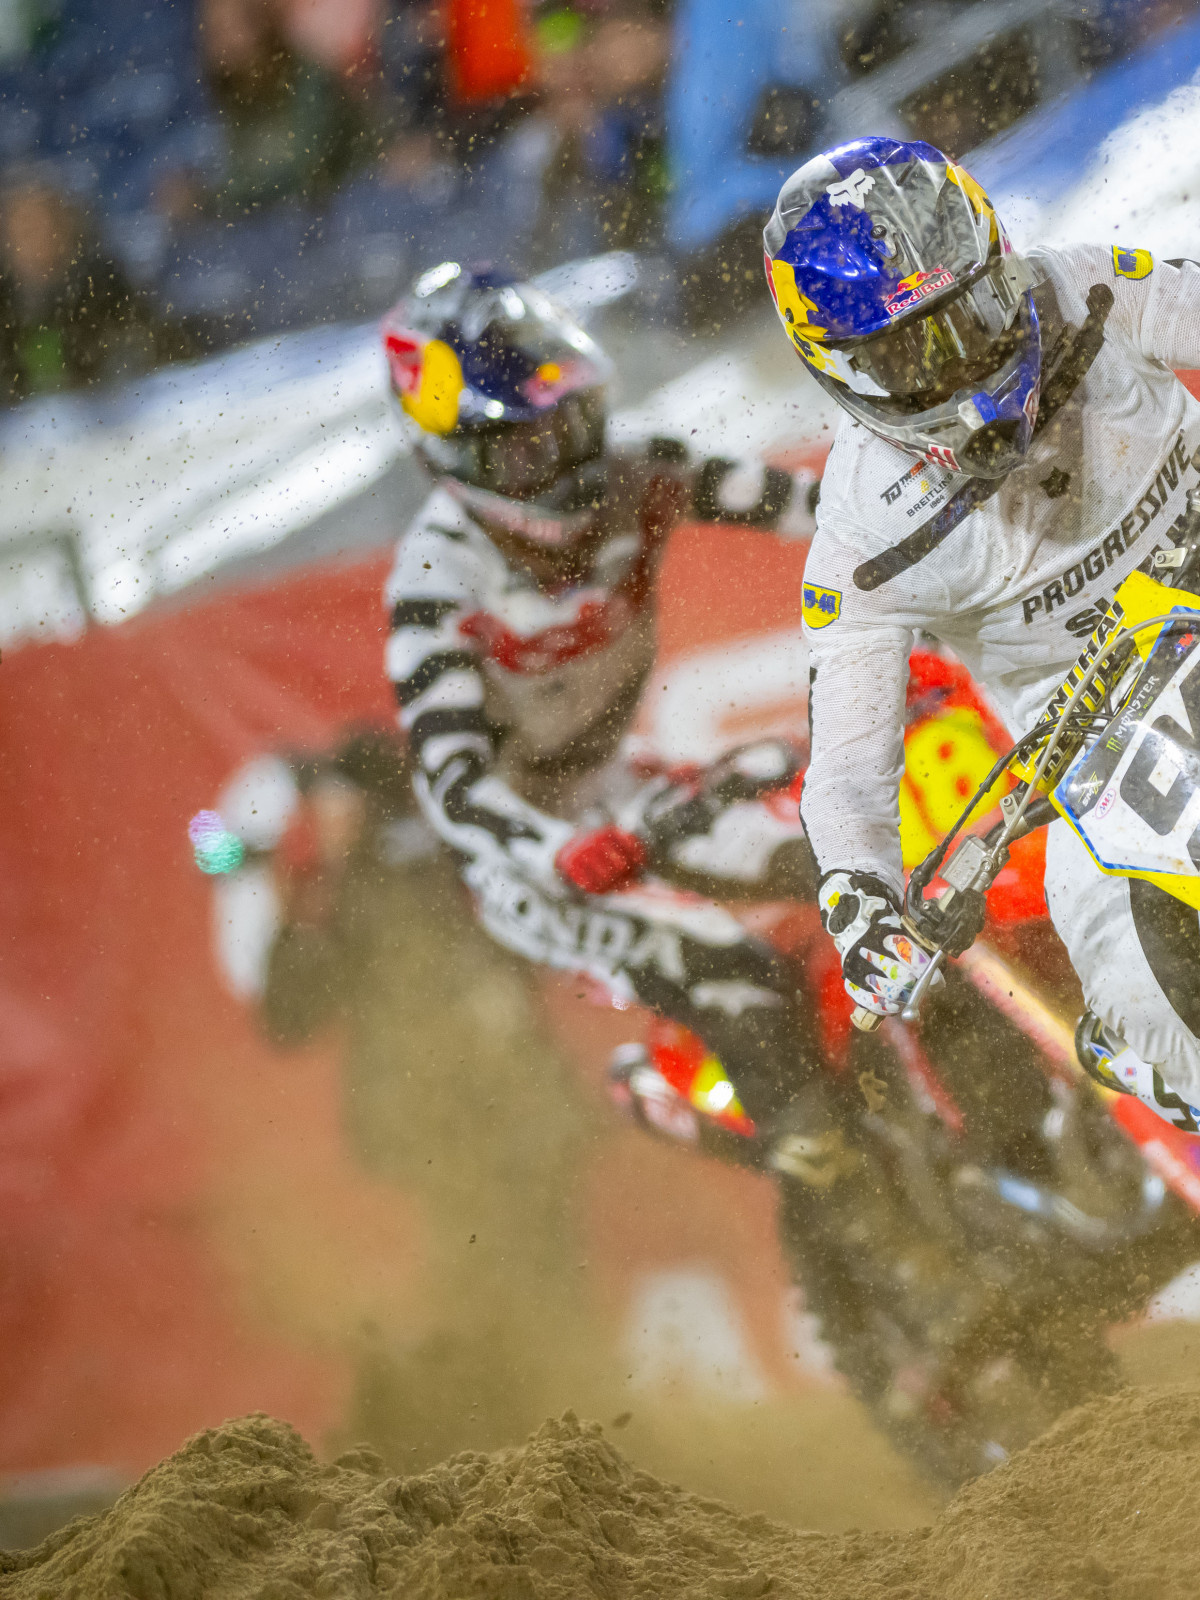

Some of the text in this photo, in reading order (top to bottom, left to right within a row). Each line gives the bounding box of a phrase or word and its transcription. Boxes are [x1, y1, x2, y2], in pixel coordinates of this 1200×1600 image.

[886, 272, 955, 316] Red Bull
[906, 473, 954, 518] BREITLING
[1022, 430, 1192, 624] PROGRESSIVE
[1114, 675, 1161, 739] MONSTER
